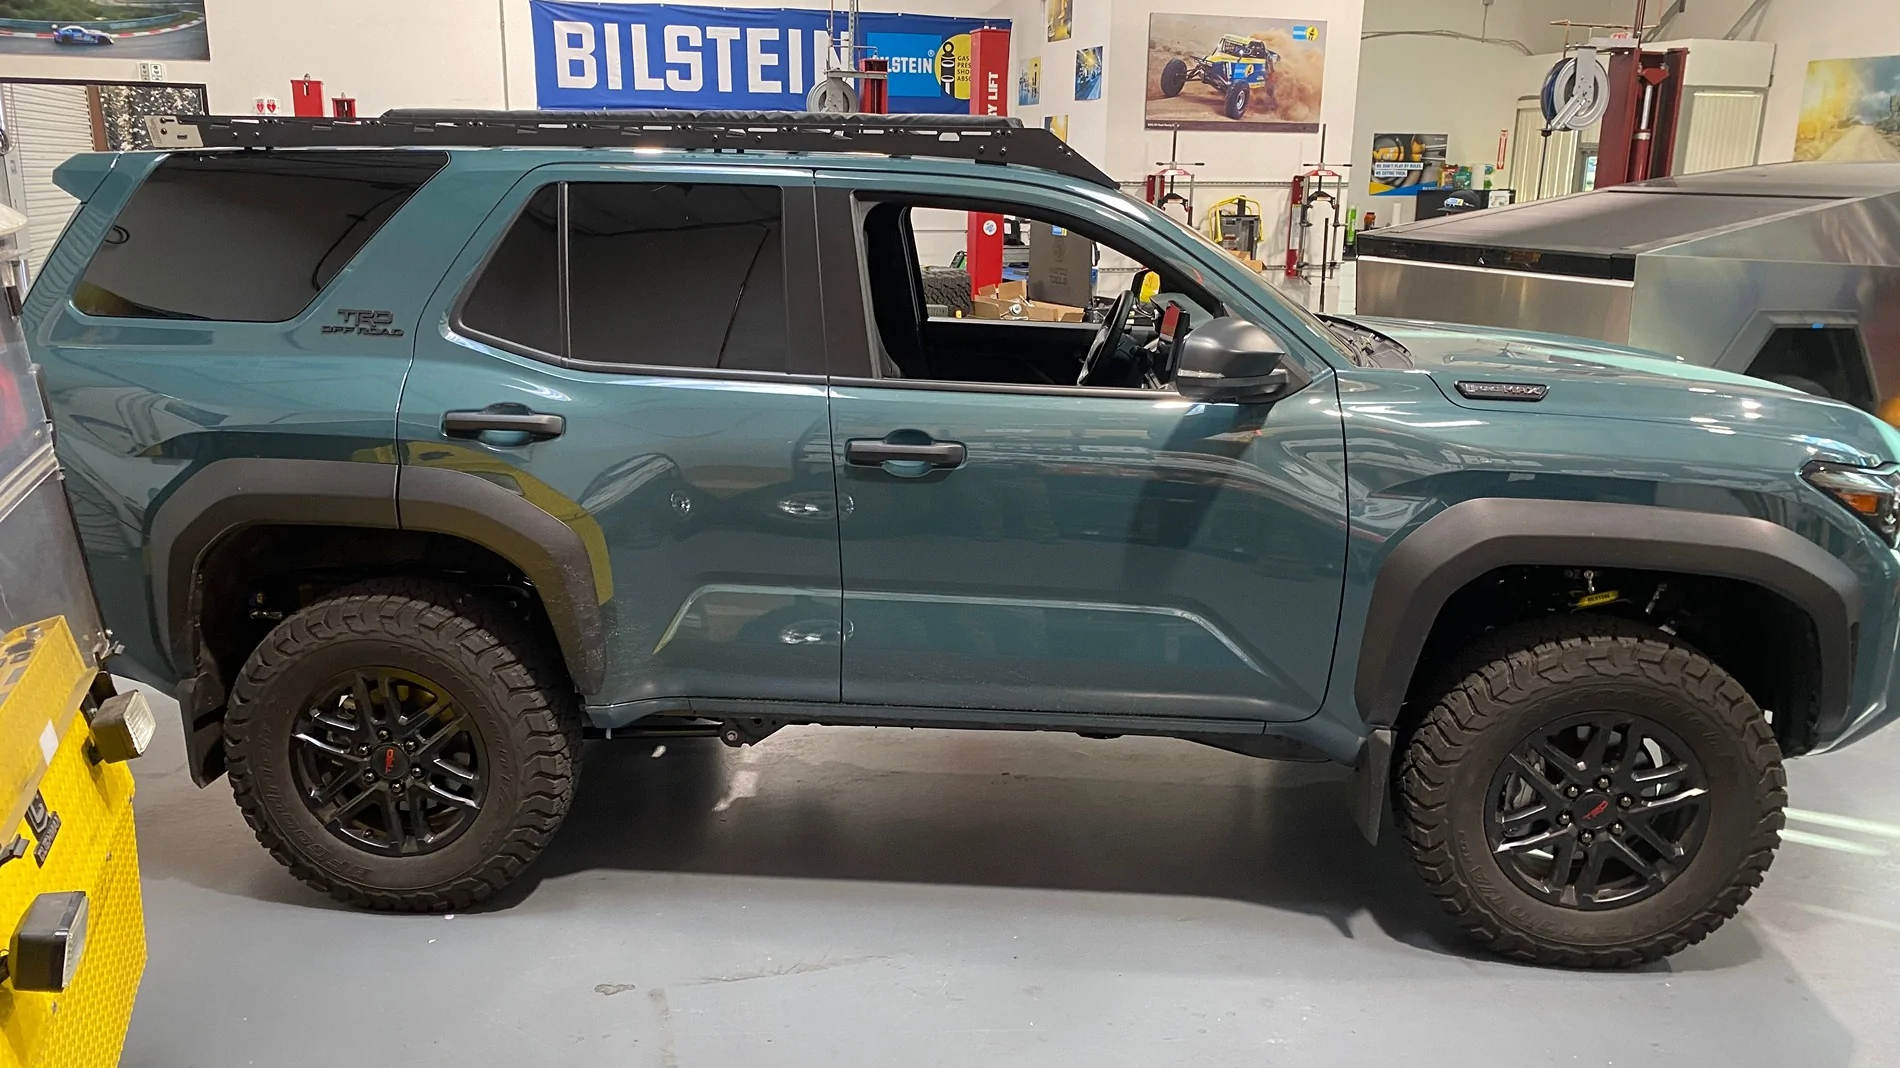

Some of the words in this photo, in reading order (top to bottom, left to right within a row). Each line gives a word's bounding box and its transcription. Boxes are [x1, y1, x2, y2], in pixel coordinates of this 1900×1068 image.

[553, 20, 855, 93] BILSTEIN
[875, 56, 933, 74] LSTEIN
[988, 72, 998, 100] LIFT
[337, 308, 394, 327] TRD
[321, 325, 356, 334] OFF
[357, 327, 405, 337] ROAD
